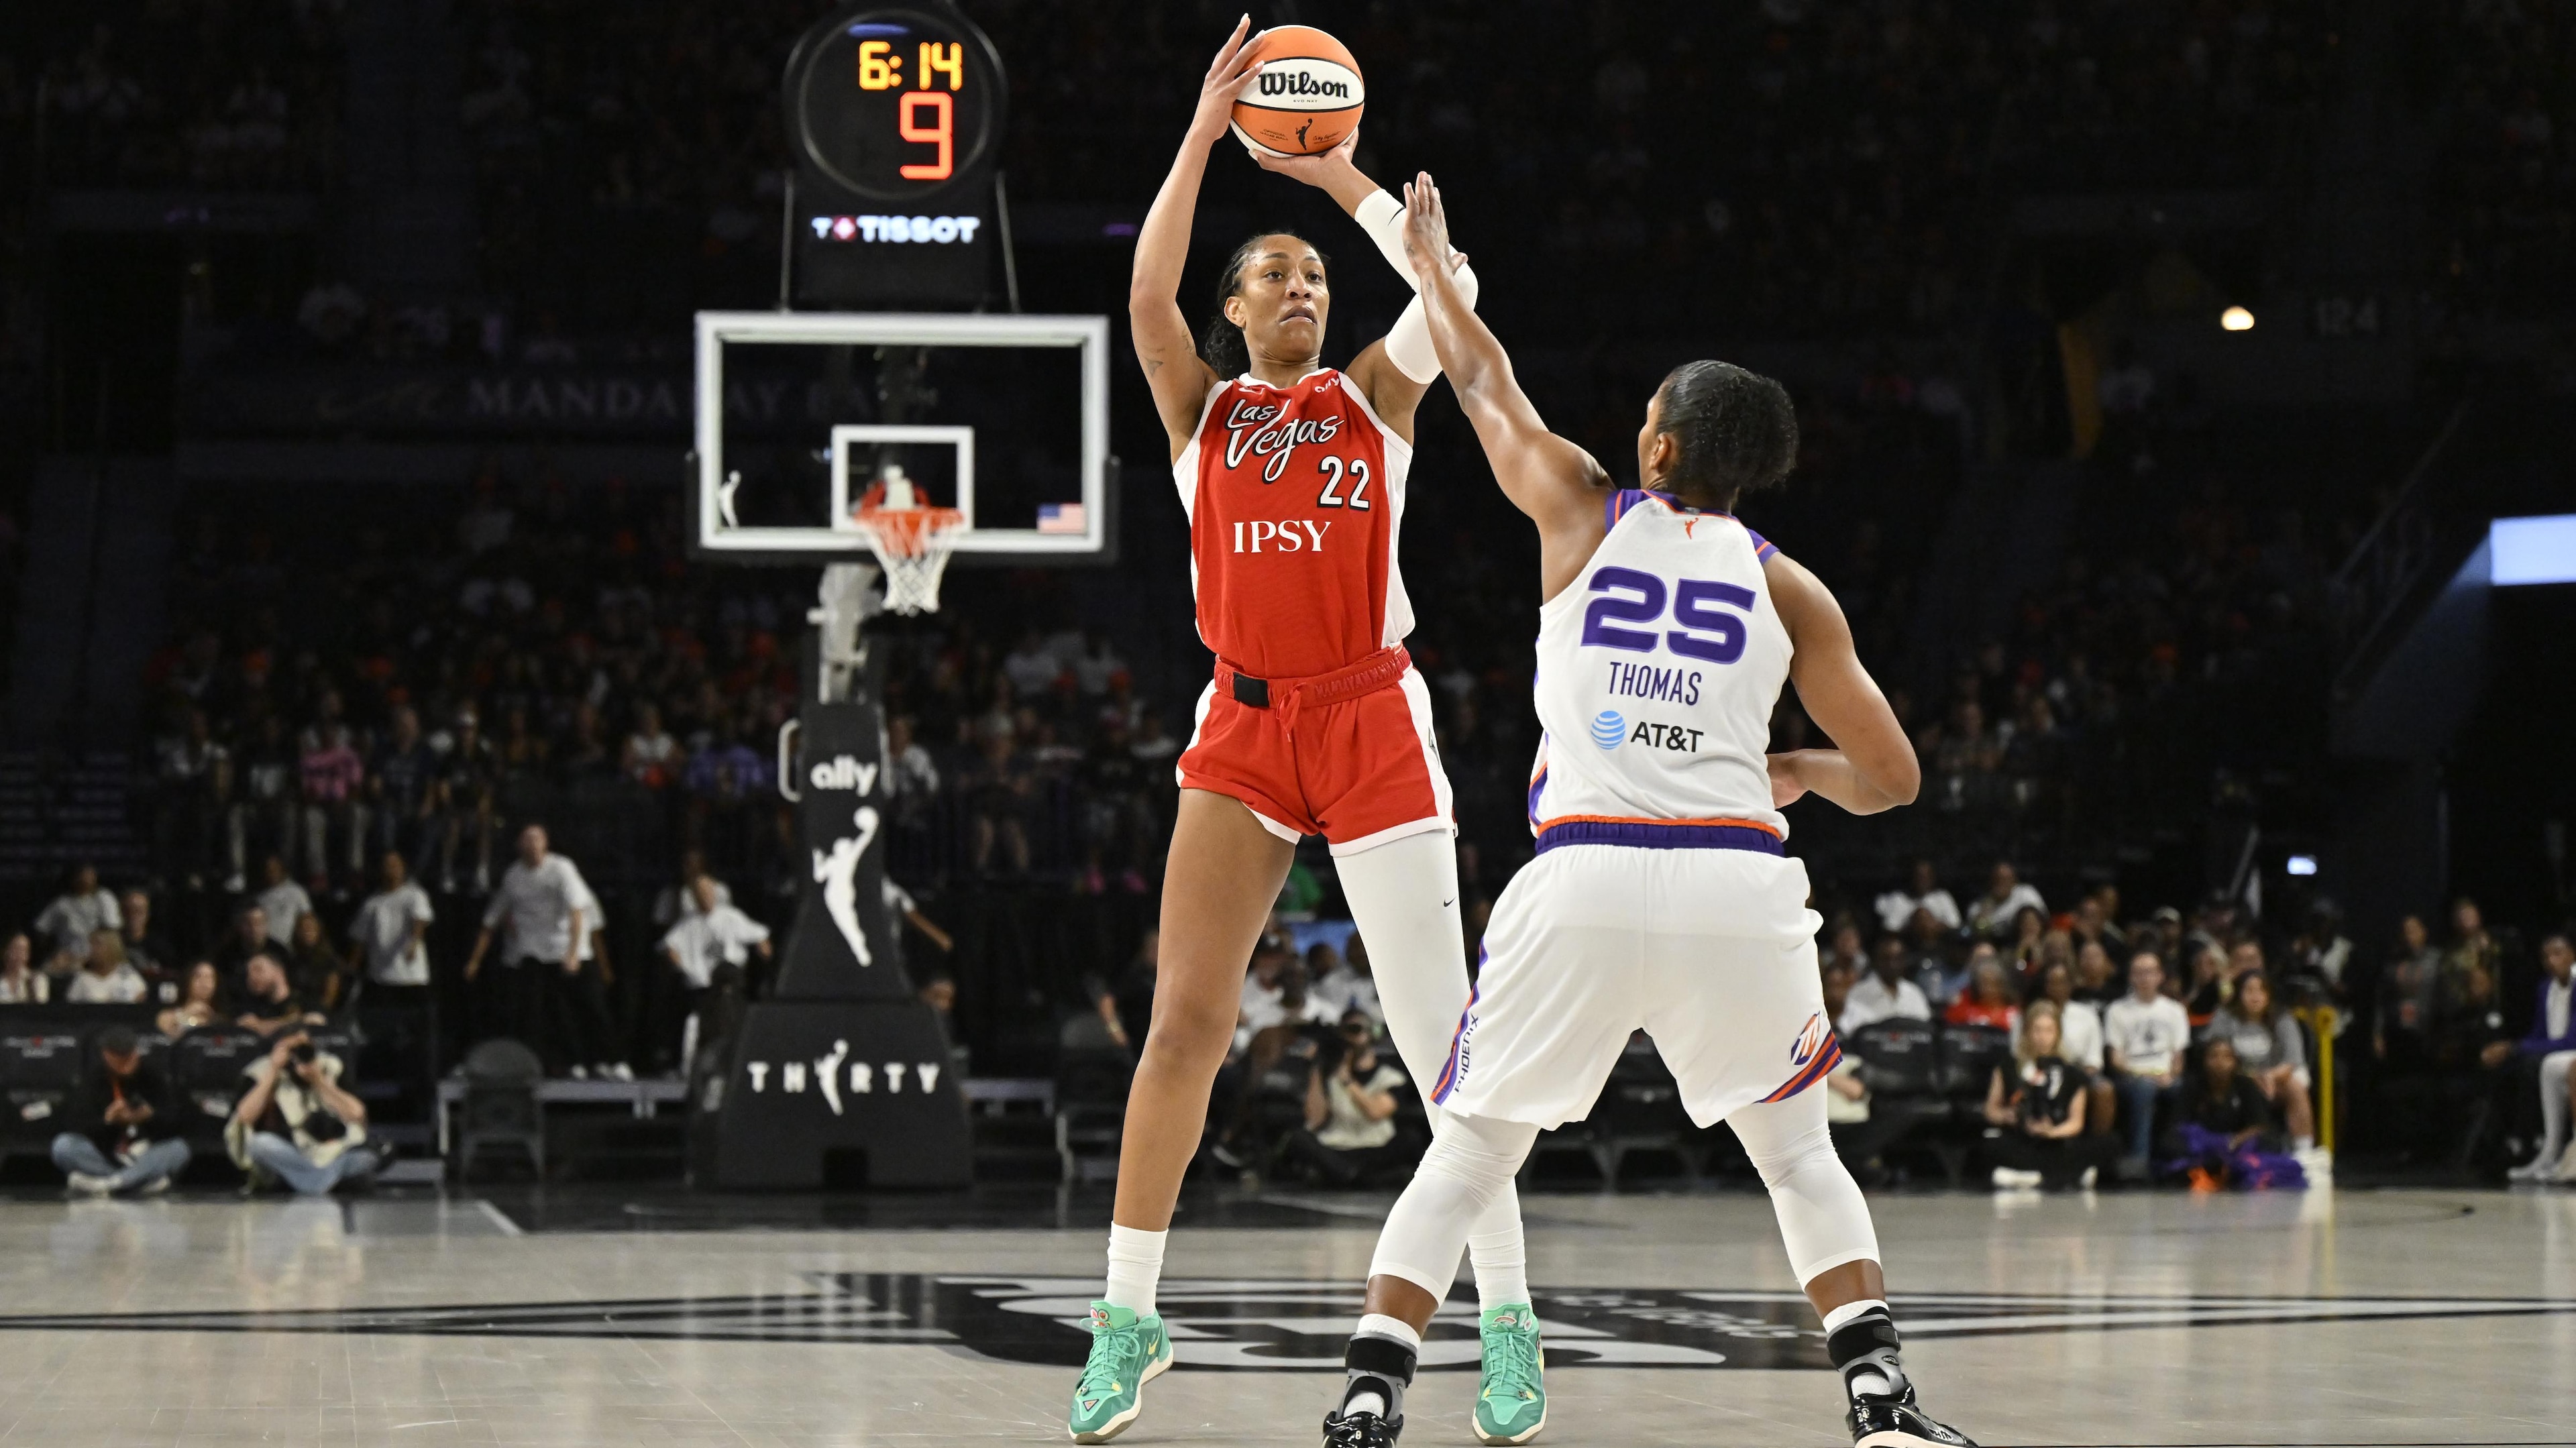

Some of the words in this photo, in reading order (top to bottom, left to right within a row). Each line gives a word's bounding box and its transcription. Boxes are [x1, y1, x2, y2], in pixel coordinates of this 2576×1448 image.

[859, 40, 962, 91] 6:14
[1258, 71, 1348, 99] Wilson
[900, 91, 953, 180] 9
[857, 215, 981, 243] TISSOT
[468, 376, 788, 417] MANDAAY
[1314, 377, 1340, 393] ally
[1226, 399, 1279, 429] Las
[1225, 398, 1345, 484] Vegas
[1317, 455, 1371, 511] 22
[1233, 520, 1332, 553] IPSY
[1580, 566, 1756, 665] 25
[1609, 661, 1702, 706] THOMAS
[1630, 721, 1704, 753] AT&T
[810, 754, 877, 797] ally
